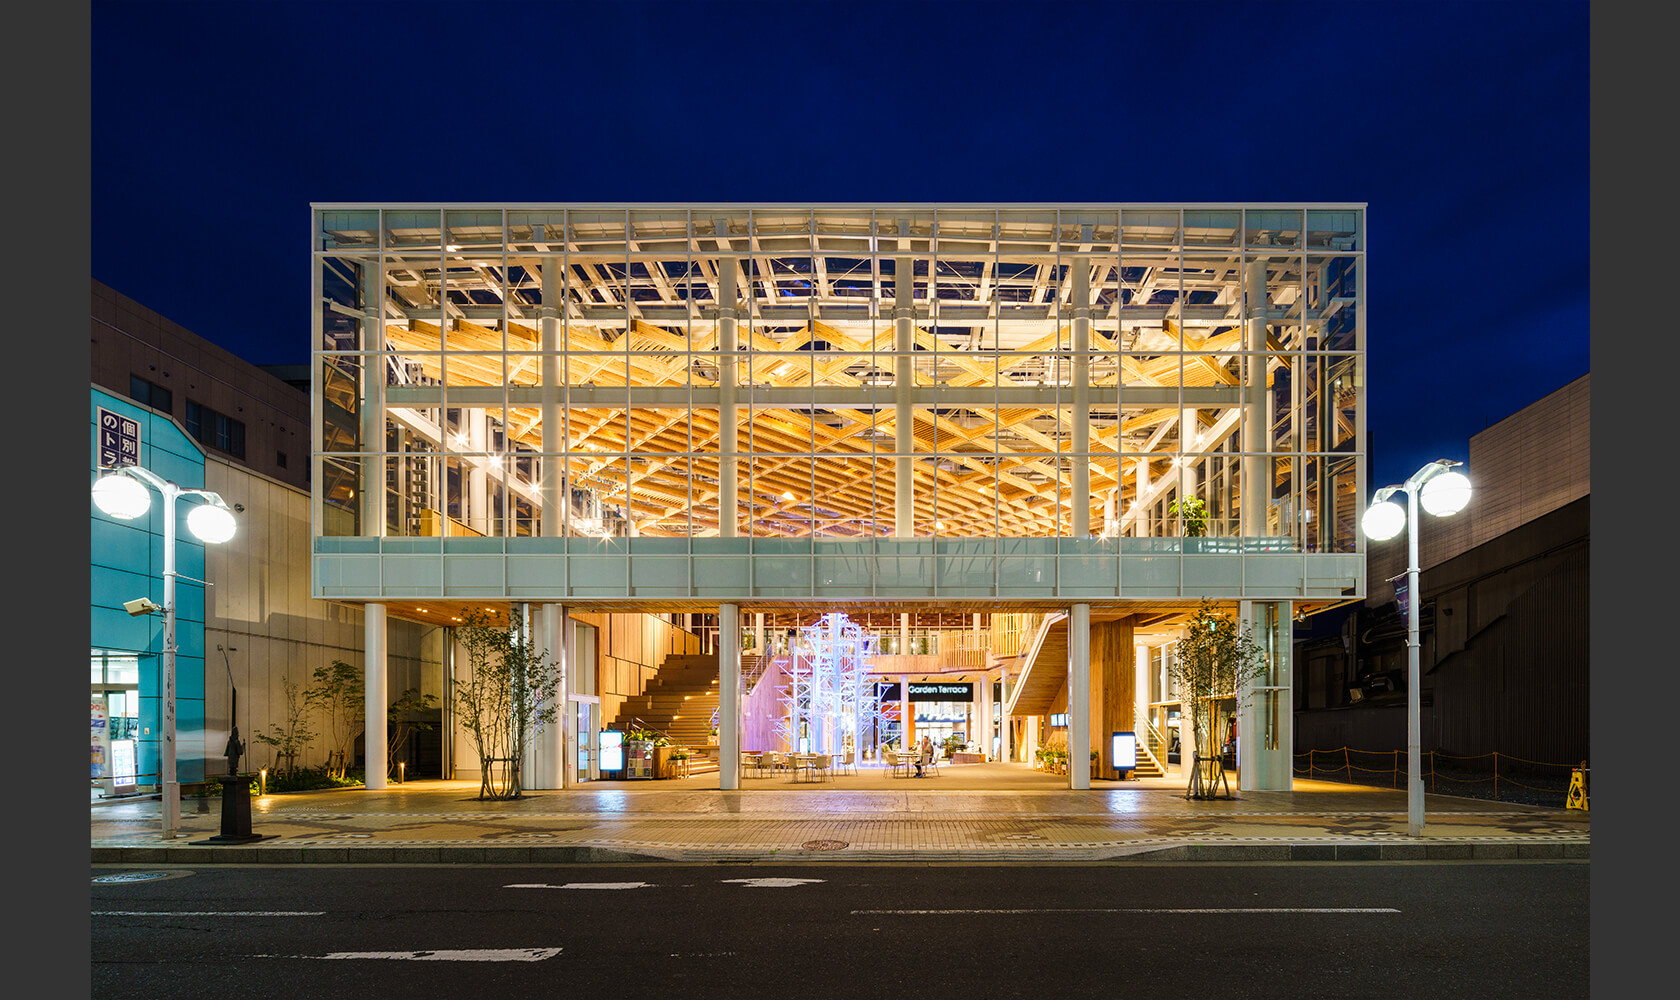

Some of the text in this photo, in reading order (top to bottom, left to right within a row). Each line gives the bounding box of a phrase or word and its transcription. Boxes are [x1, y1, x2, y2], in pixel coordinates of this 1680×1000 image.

[103, 415, 118, 465] のトラ
[908, 685, 968, 694] Garden Terrace
